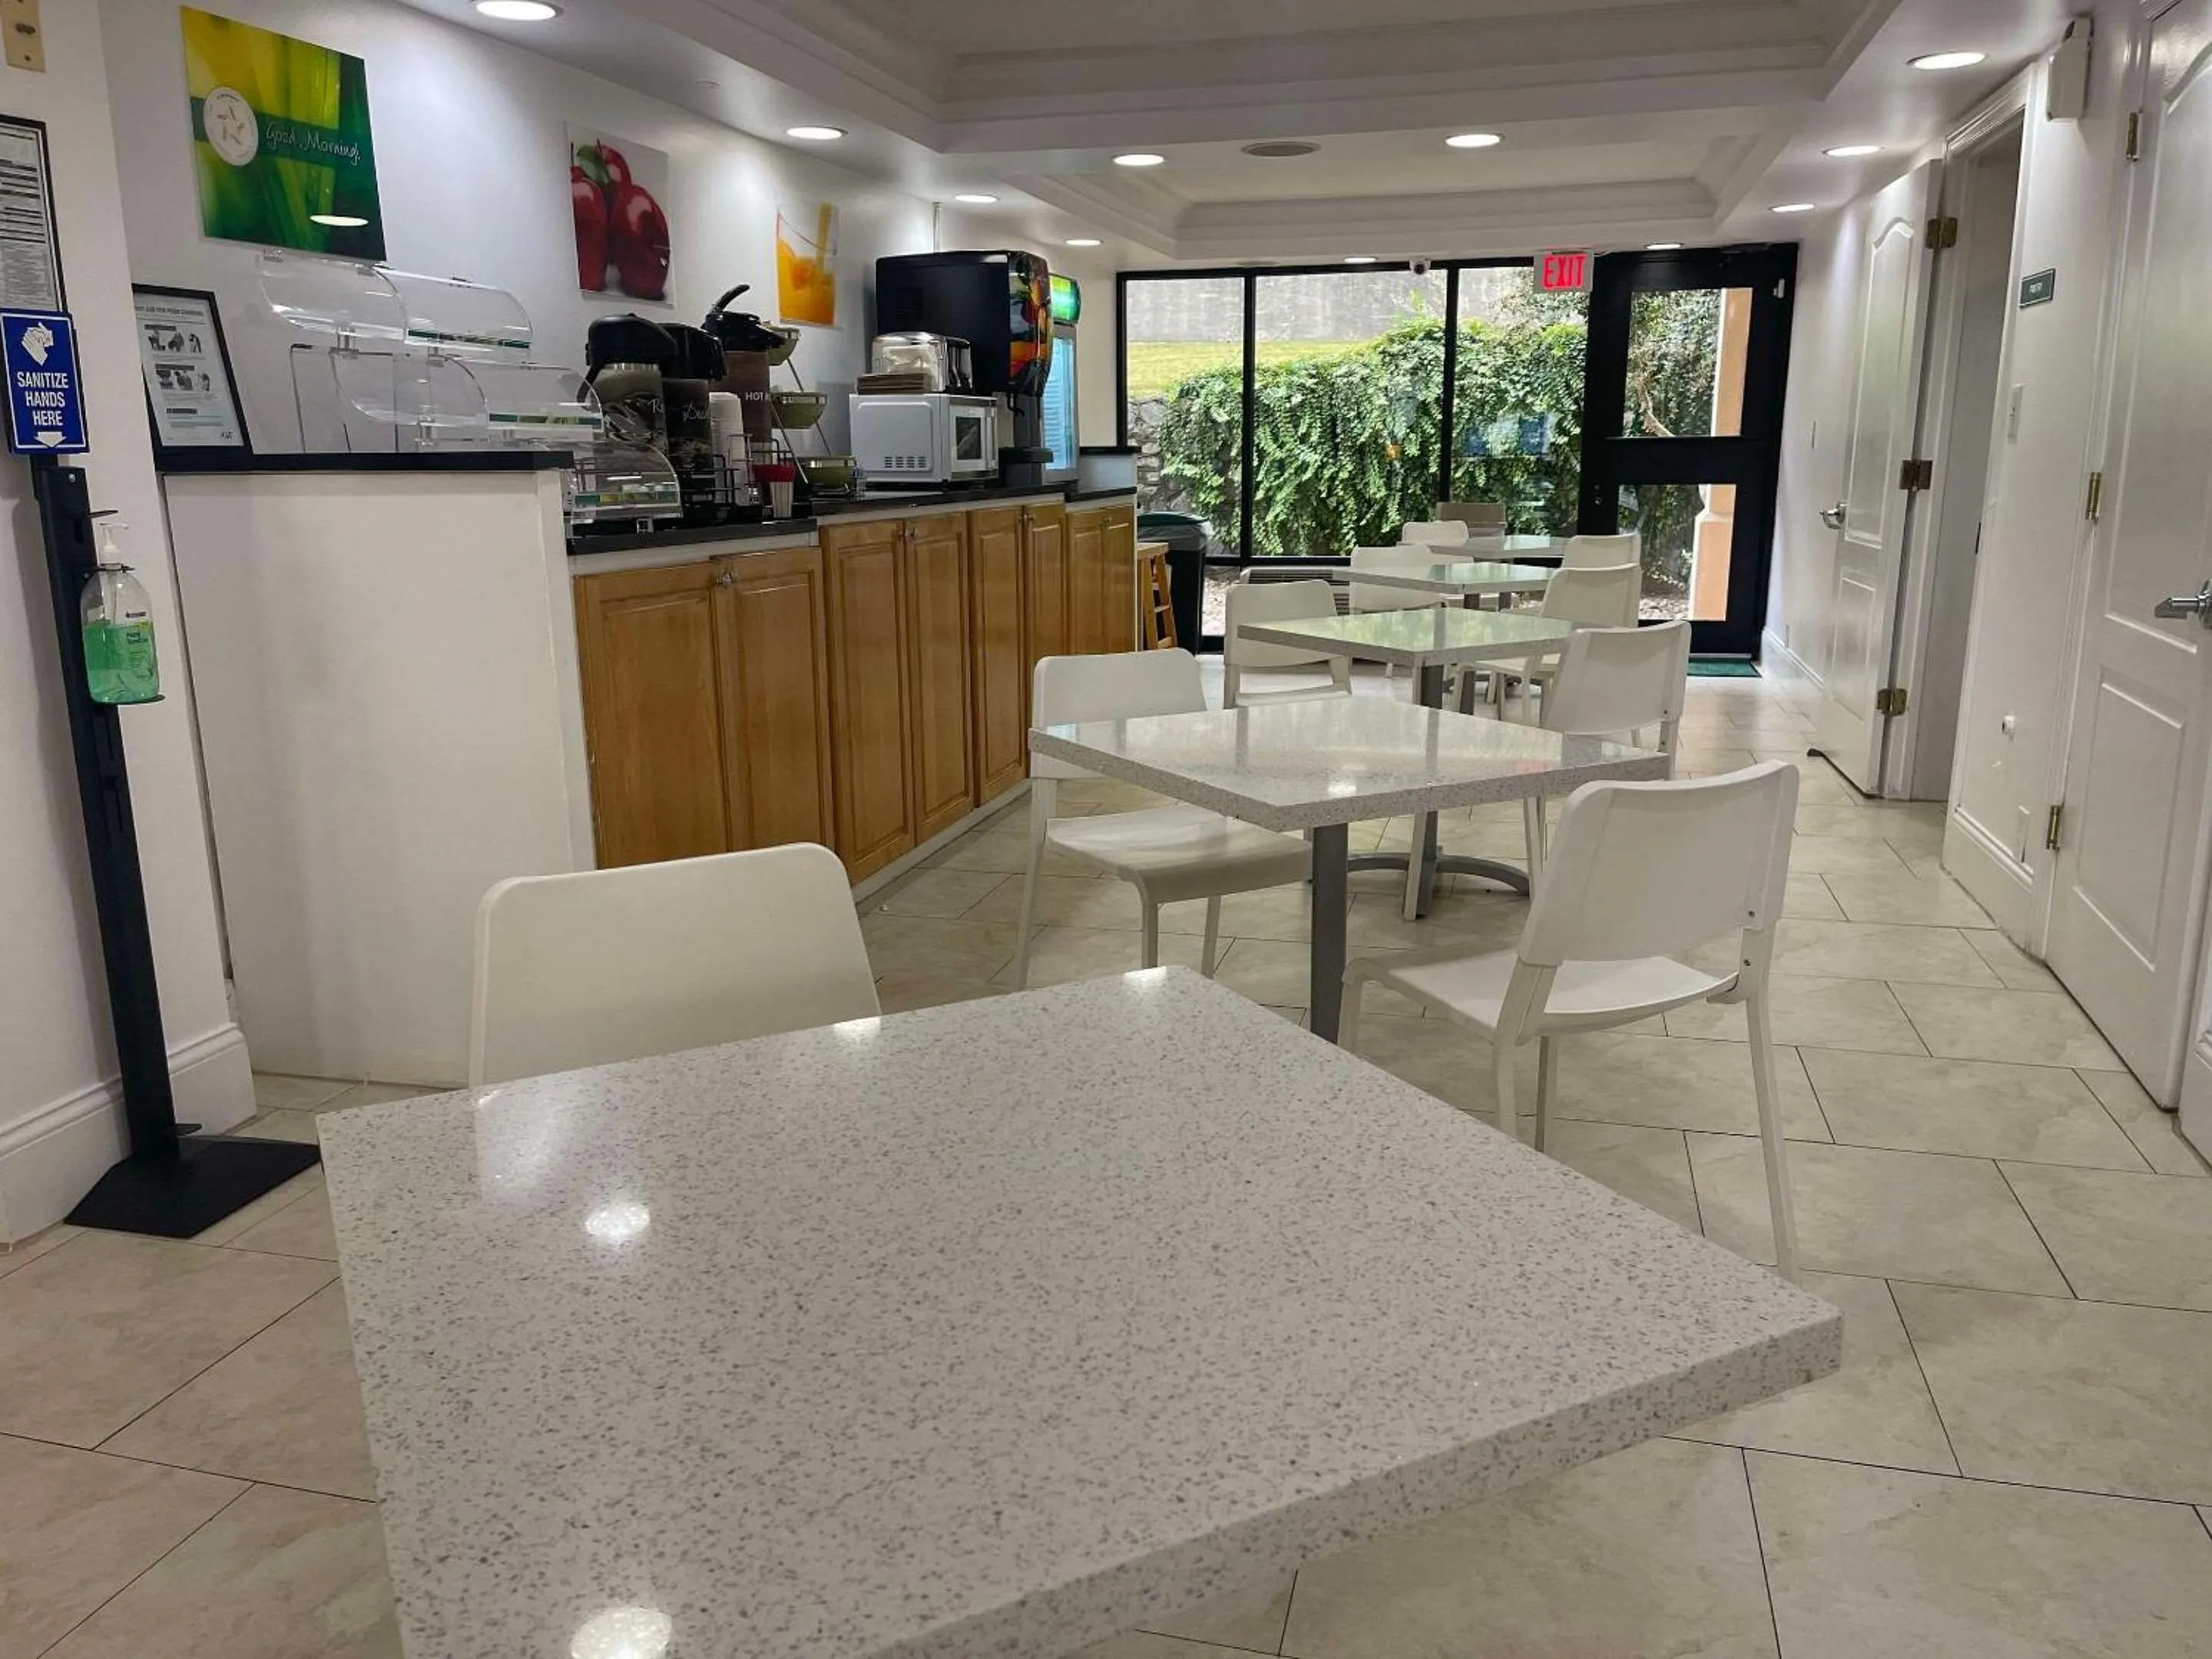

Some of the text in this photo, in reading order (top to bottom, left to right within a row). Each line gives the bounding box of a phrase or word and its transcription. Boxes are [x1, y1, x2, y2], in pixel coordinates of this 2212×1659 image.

[266, 121, 296, 151] Good
[1543, 255, 1586, 287] EXIT
[16, 371, 68, 389] SANITIZE
[25, 390, 66, 408] HANDS
[745, 391, 763, 401] HOT
[32, 409, 64, 426] HERE
